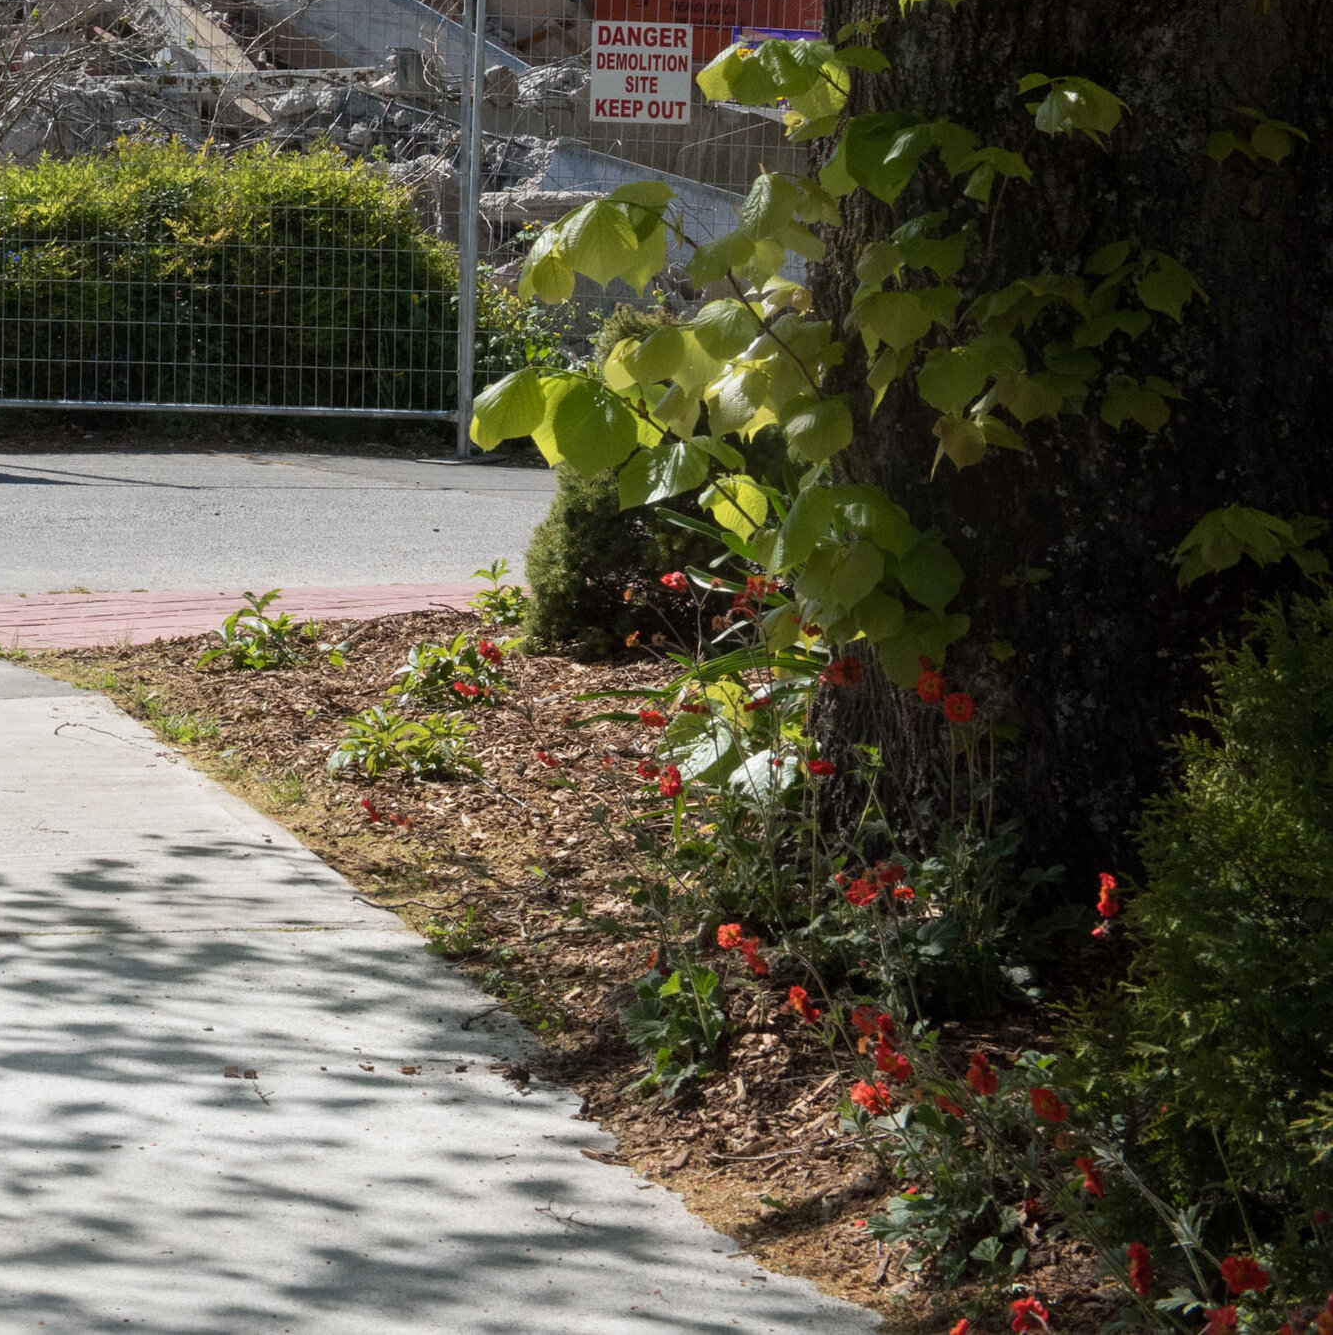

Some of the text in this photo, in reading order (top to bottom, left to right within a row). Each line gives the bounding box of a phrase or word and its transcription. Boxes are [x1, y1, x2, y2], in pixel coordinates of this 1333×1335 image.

[598, 25, 687, 48] DANGER
[596, 52, 688, 73] DEMOLITION
[625, 76, 659, 94] SITE
[595, 98, 687, 120] KEEP OUT
